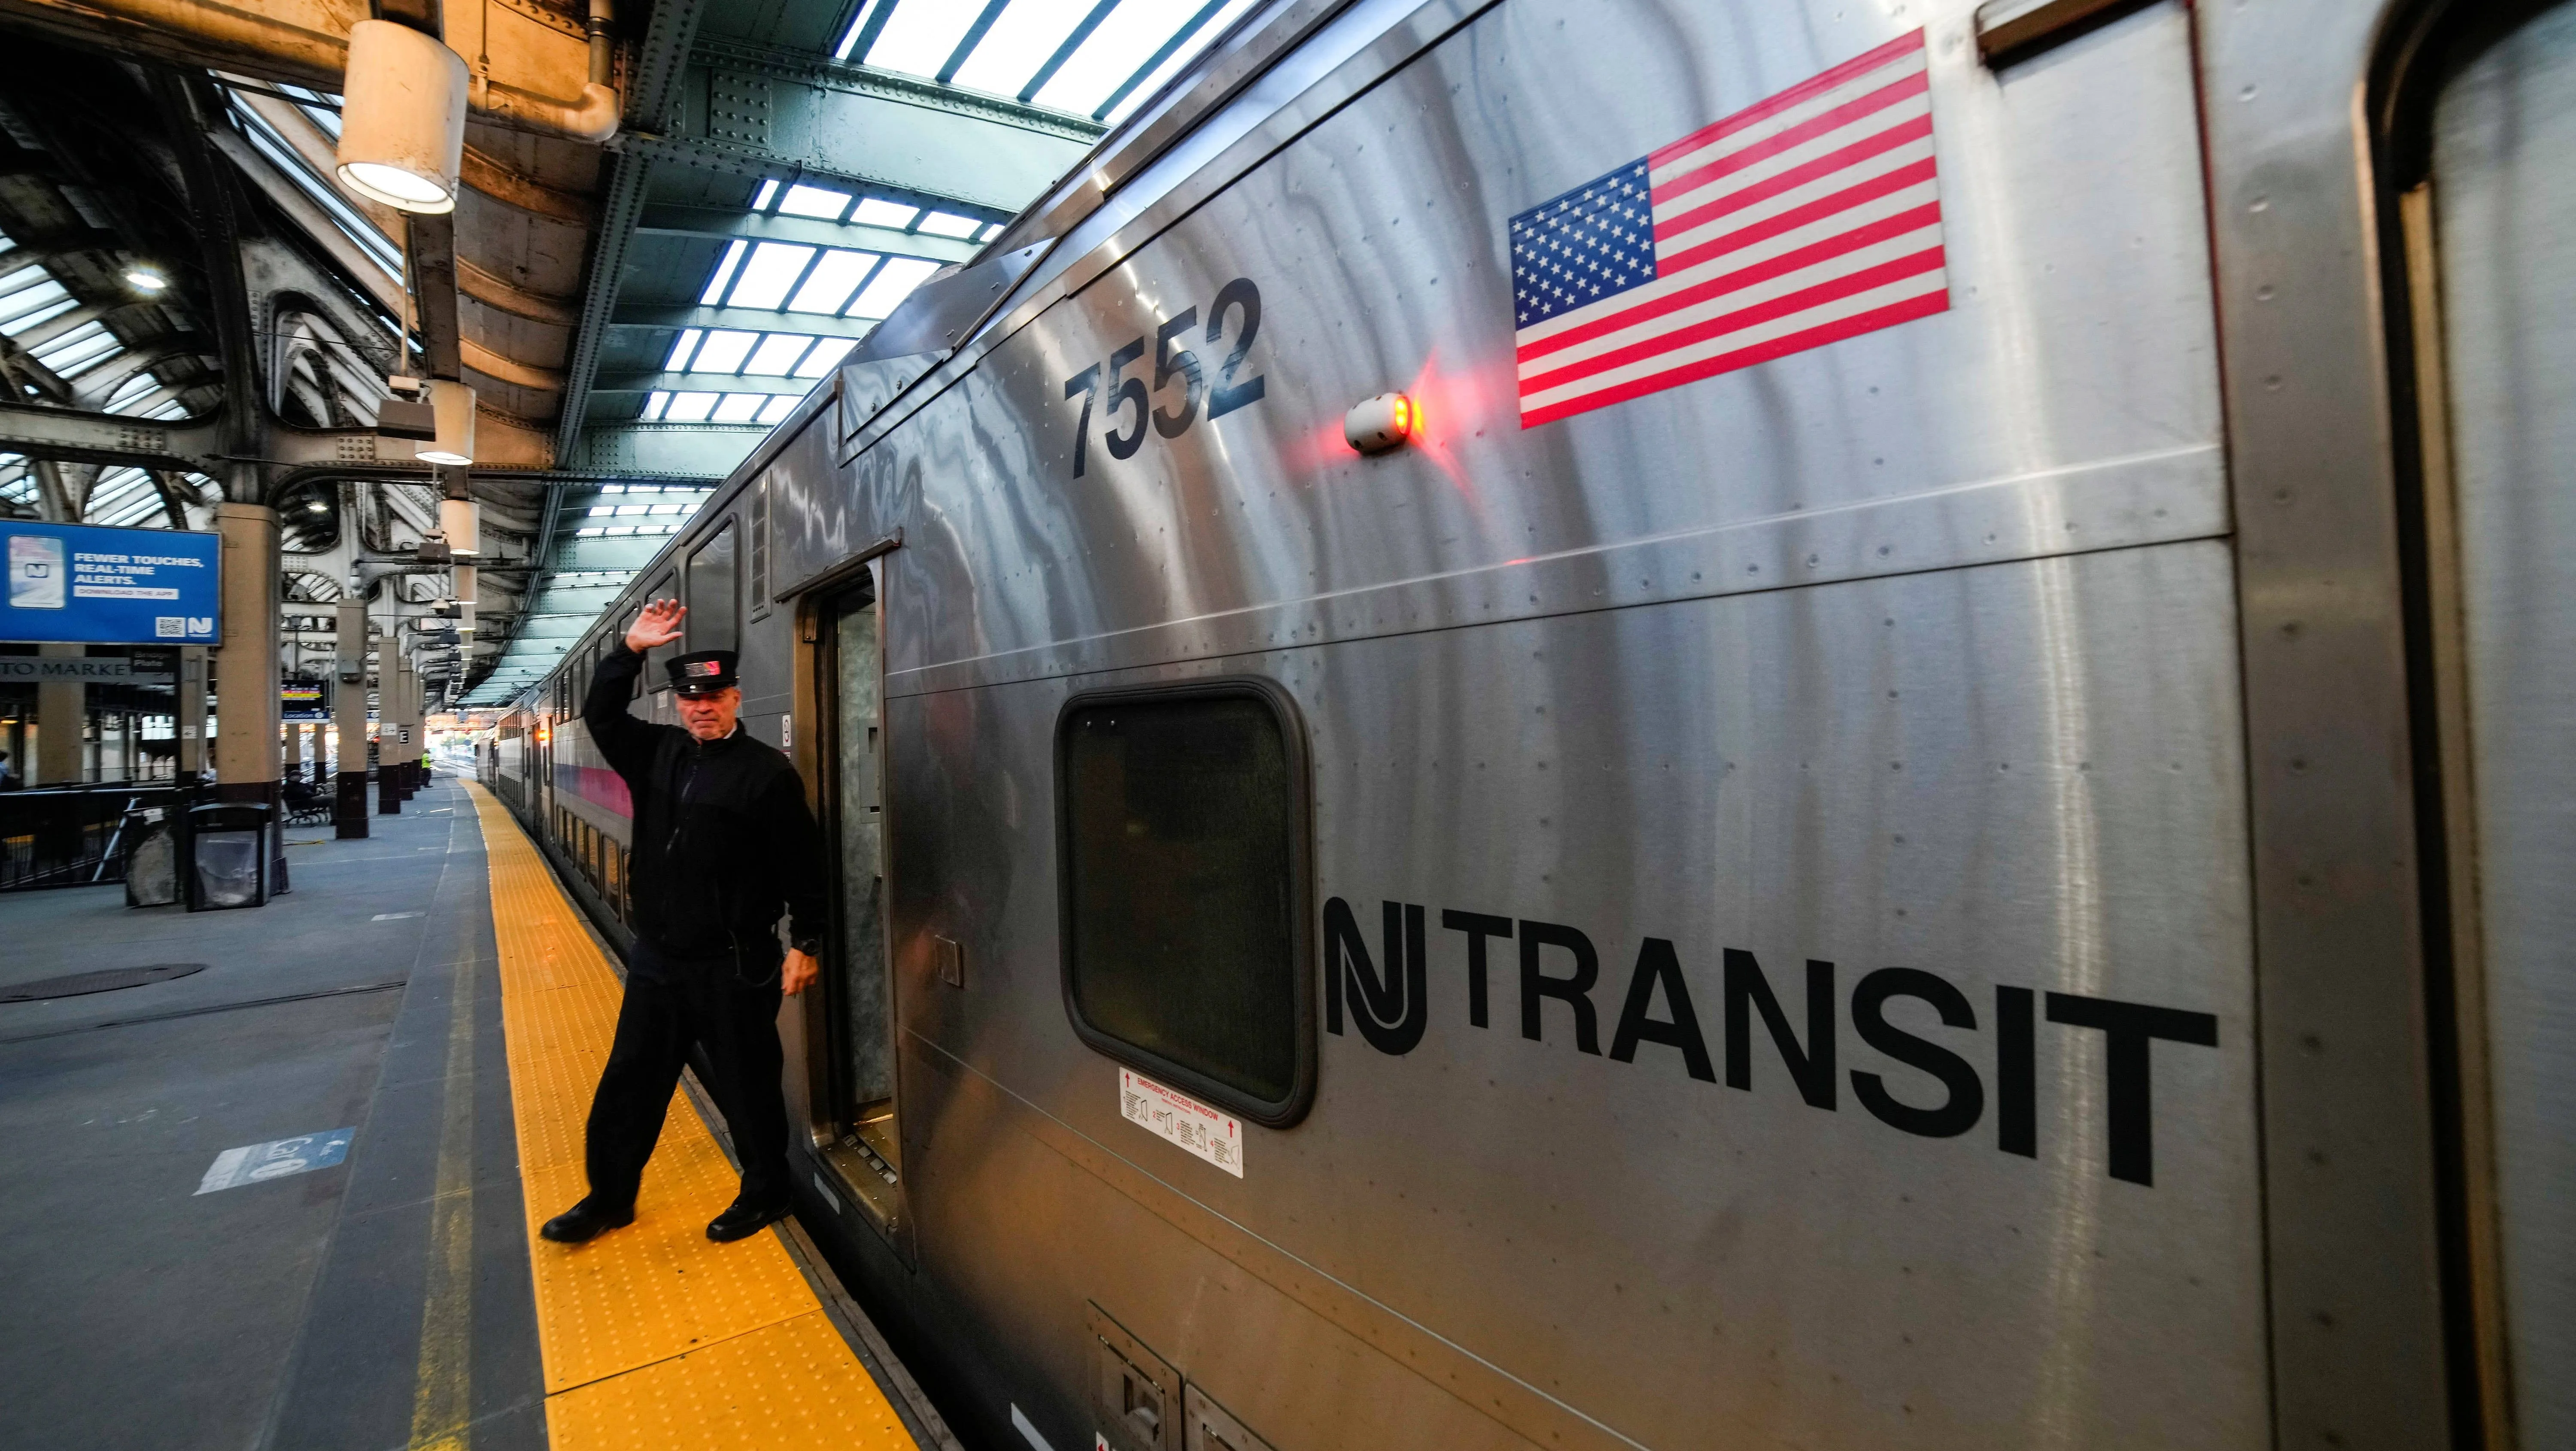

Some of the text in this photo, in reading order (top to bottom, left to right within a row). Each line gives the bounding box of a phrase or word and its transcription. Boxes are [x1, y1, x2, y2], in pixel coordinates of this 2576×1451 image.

[1065, 278, 1265, 480] 7552
[74, 553, 205, 568] FEWER TOUCHES,
[74, 564, 155, 575] REAL-TIME
[74, 574, 137, 584] ALERTS.
[0, 663, 134, 675] TO MARKE
[399, 732, 408, 742] E
[1442, 908, 2218, 1188] TRANSIT
[1137, 1078, 1169, 1098] EMERGENCY
[1170, 1094, 1192, 1109] ACCESS
[1193, 1103, 1219, 1121] WINDOW
